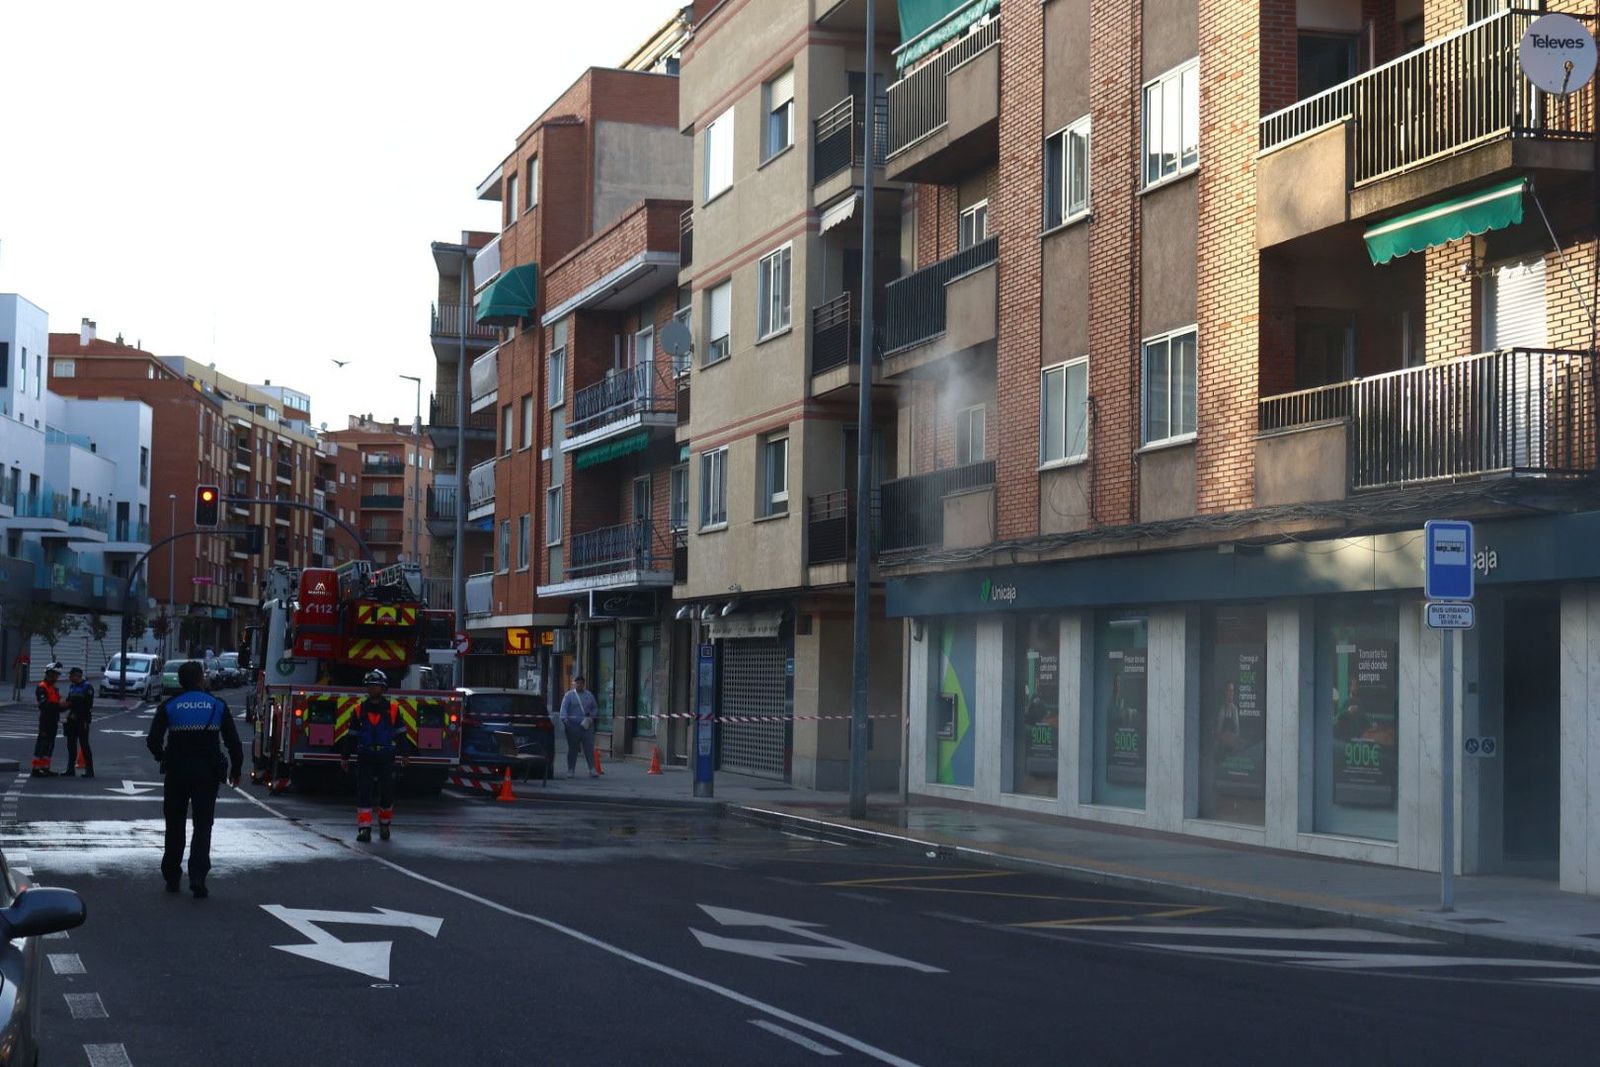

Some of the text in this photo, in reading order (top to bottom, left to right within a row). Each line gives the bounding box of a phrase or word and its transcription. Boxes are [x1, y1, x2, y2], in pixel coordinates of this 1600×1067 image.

[1530, 34, 1585, 49] Televes
[992, 584, 1016, 604] Unicaja
[315, 604, 333, 614] 112
[1358, 649, 1380, 658] Tomarte
[1371, 659, 1388, 670] donde
[1358, 672, 1380, 684] siempre
[177, 700, 213, 710] POLICÍA
[1031, 727, 1053, 745] 900€
[1114, 732, 1139, 752] 900€
[1345, 742, 1382, 766] 900€
